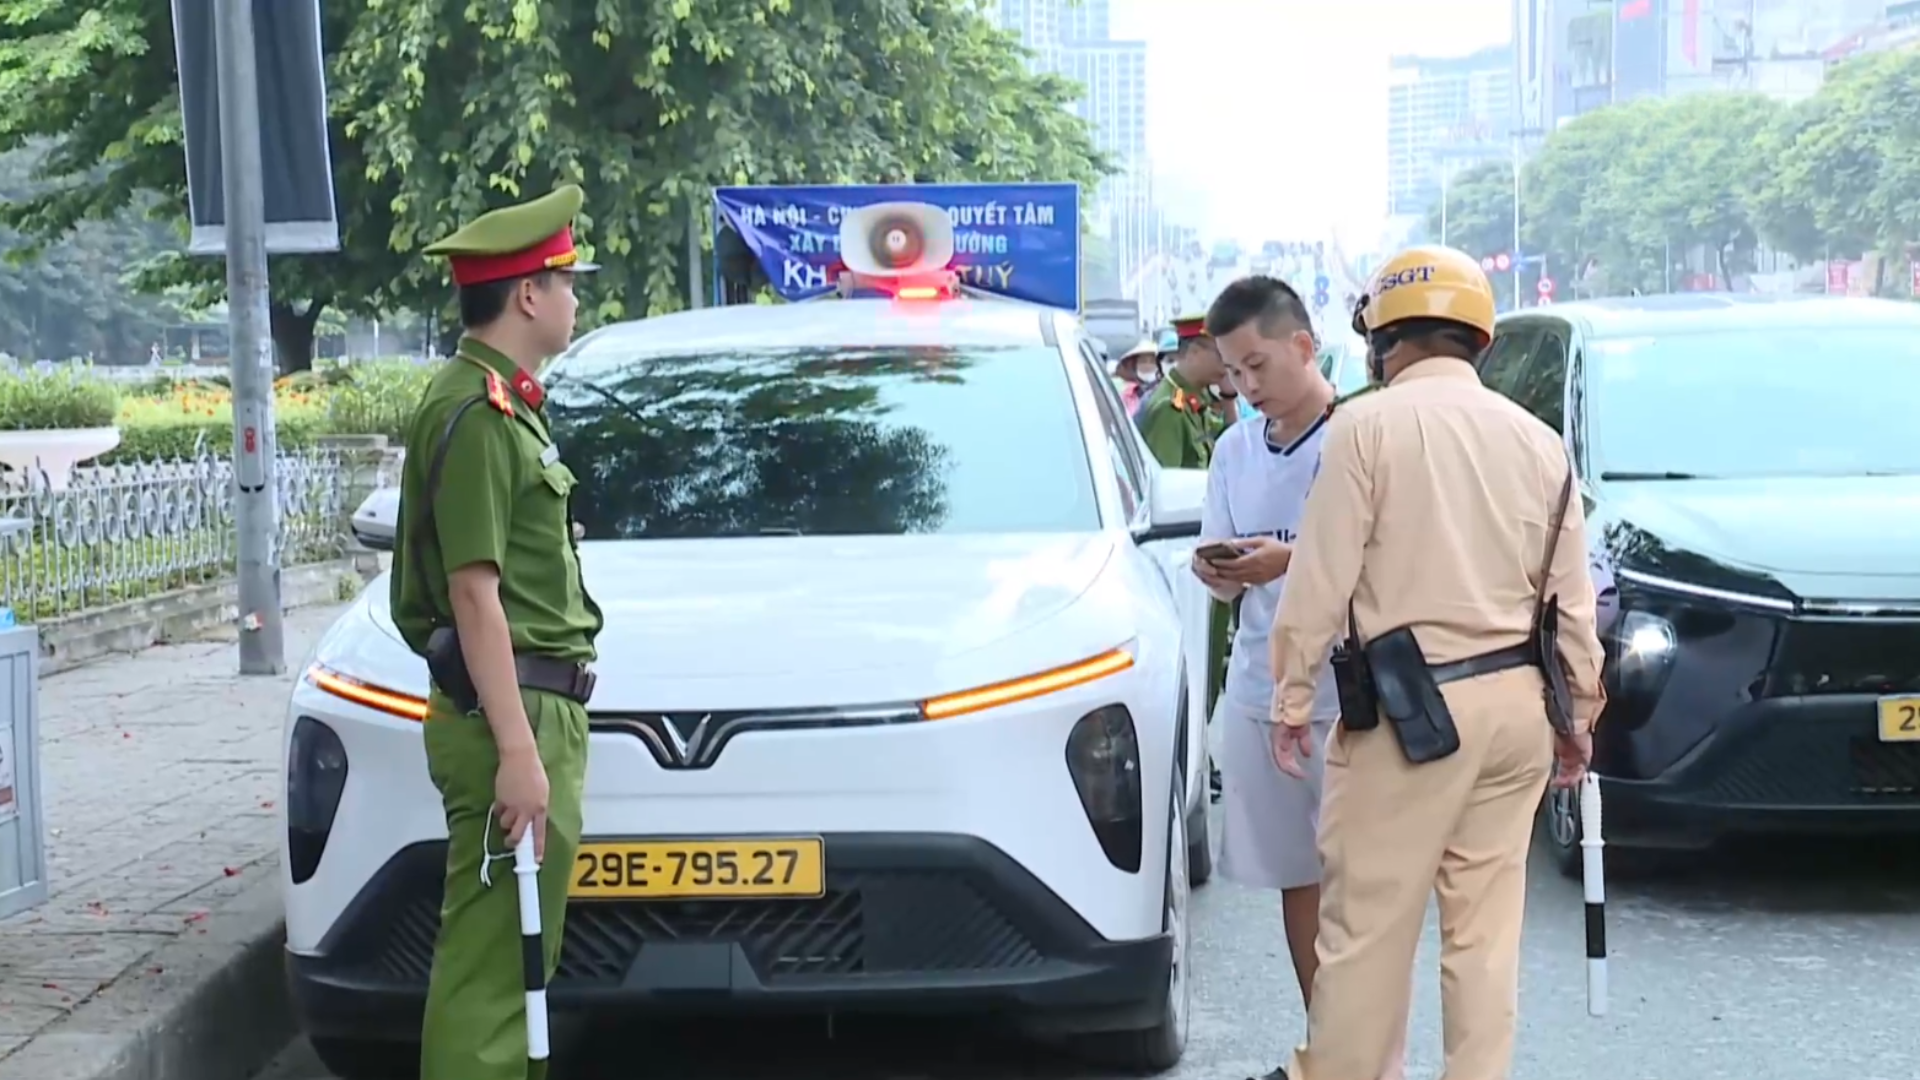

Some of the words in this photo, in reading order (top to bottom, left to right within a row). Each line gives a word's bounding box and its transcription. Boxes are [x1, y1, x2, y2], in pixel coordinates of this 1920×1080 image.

[955, 231, 1008, 254] ƯỜNG
[784, 259, 827, 288] KH
[1899, 705, 1920, 731] 2
[577, 850, 798, 887] 29E-795.27
